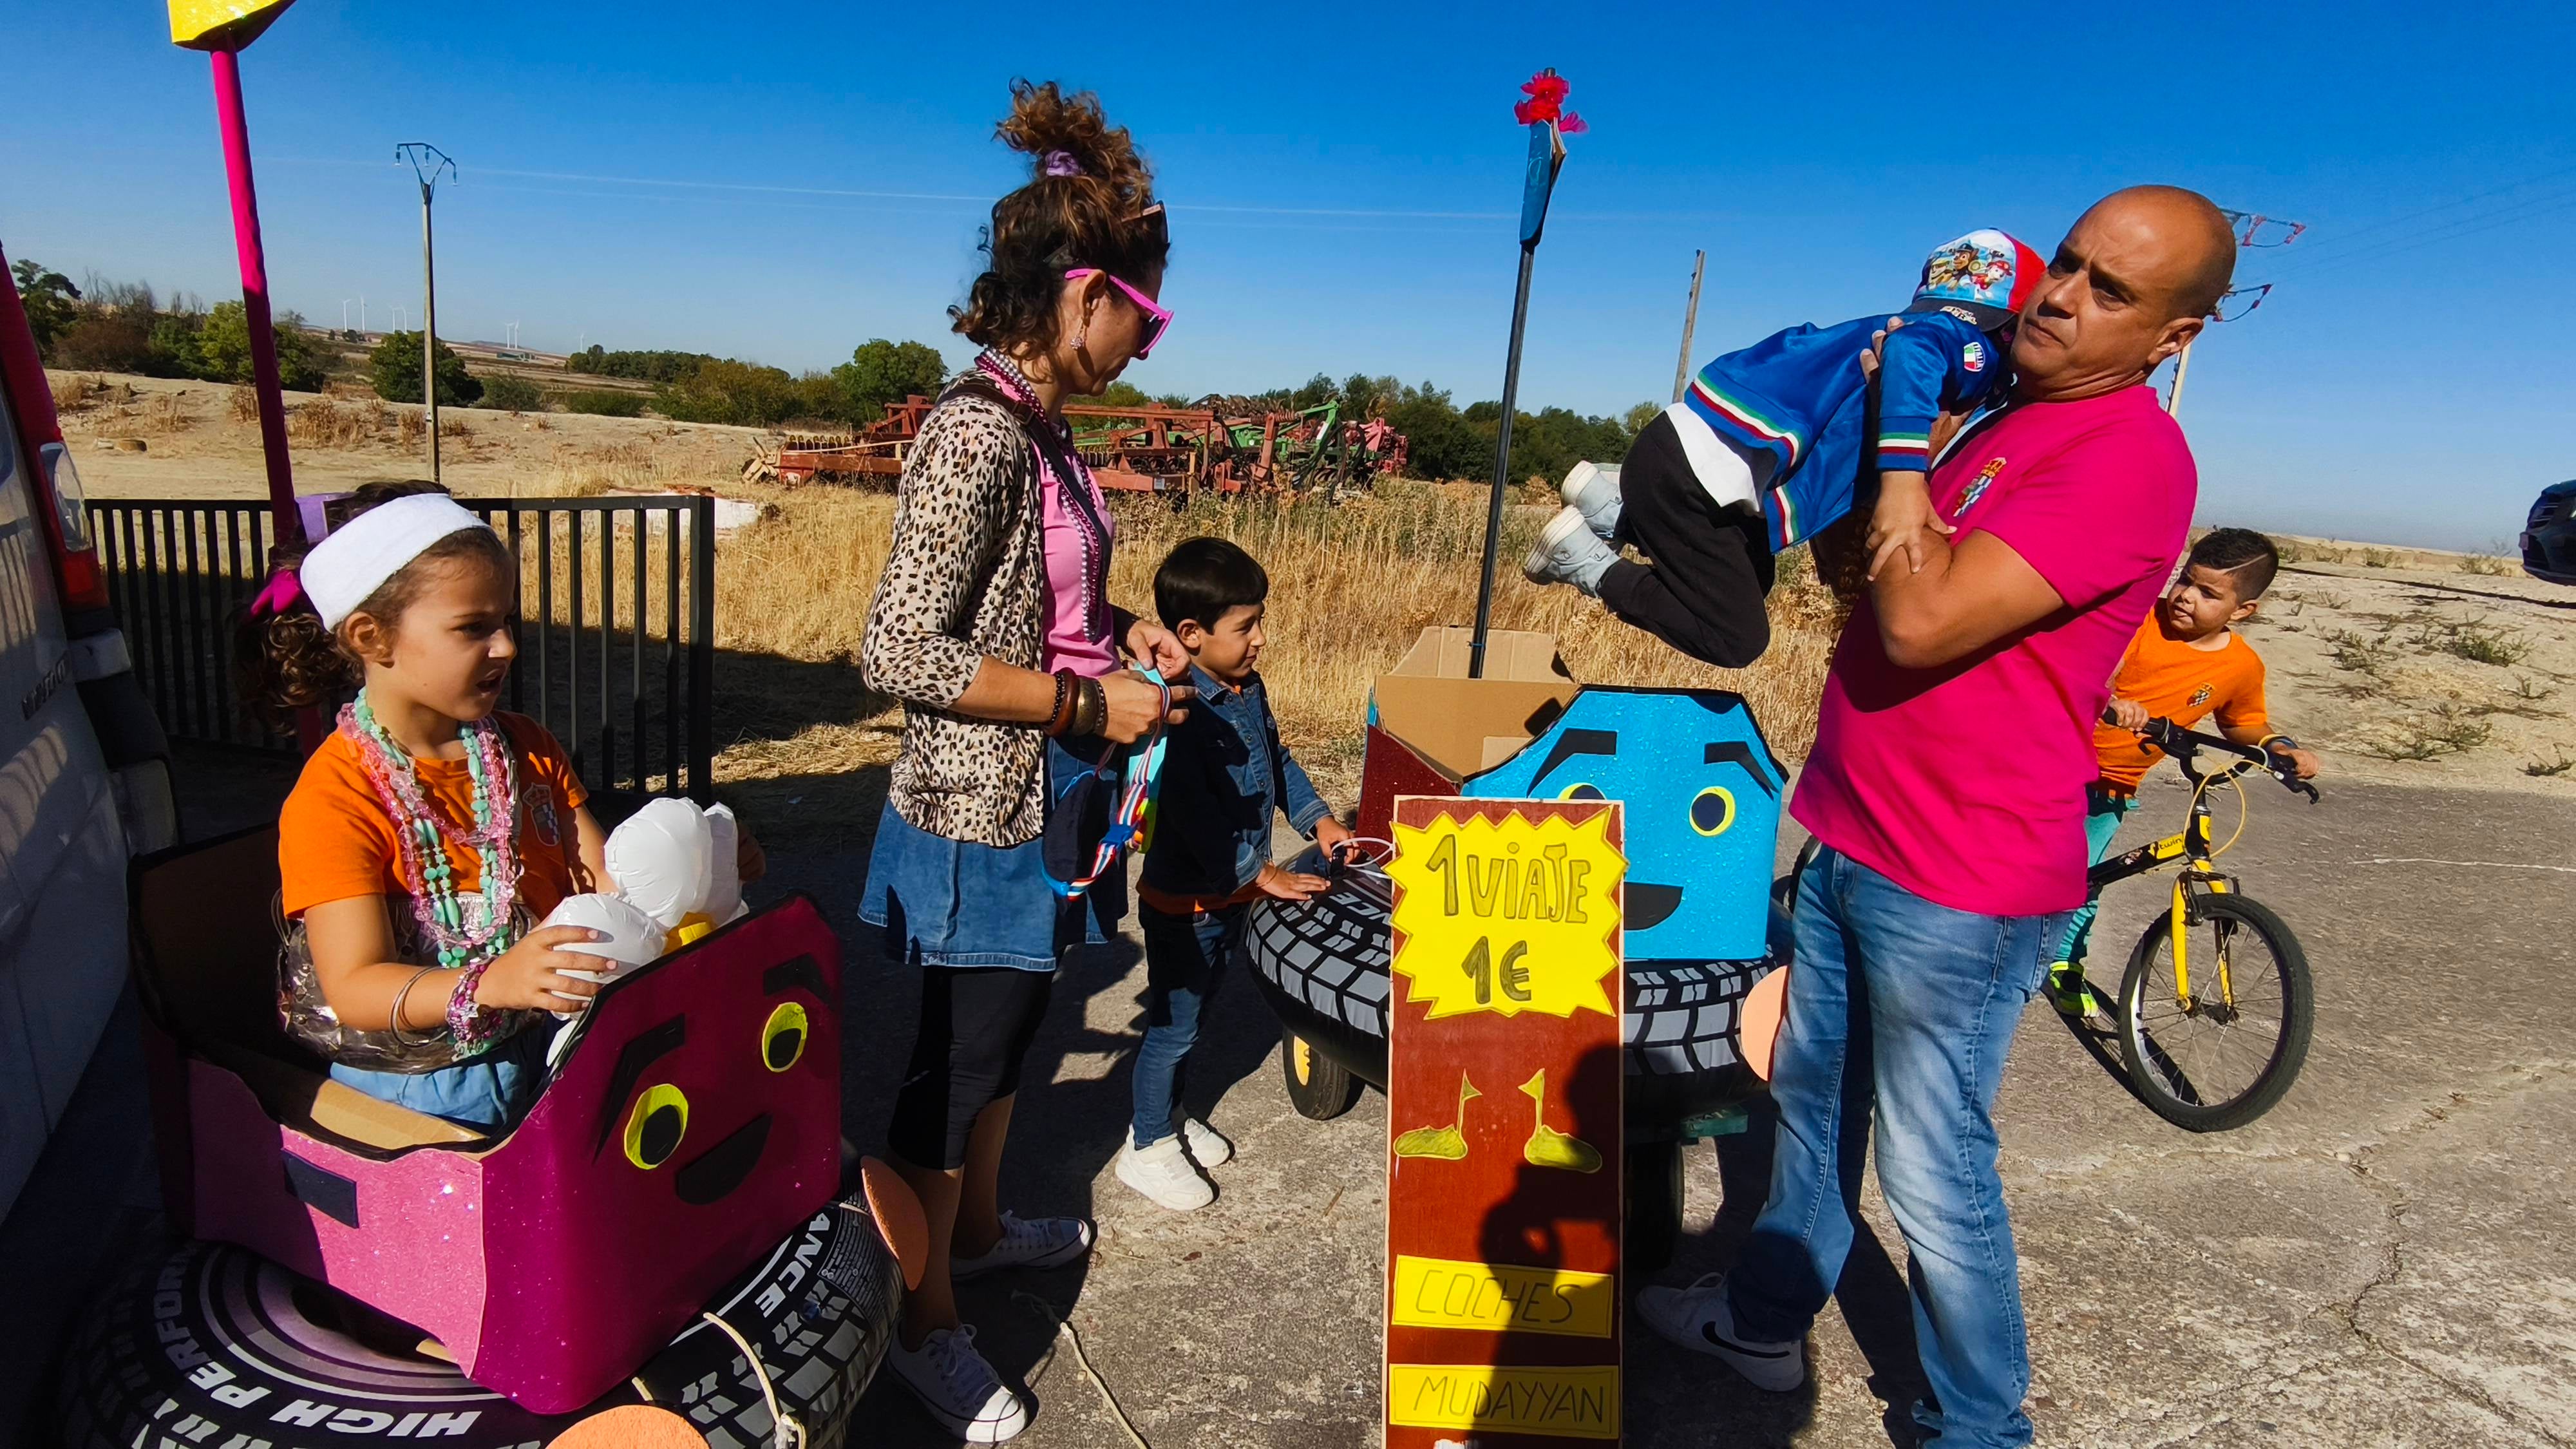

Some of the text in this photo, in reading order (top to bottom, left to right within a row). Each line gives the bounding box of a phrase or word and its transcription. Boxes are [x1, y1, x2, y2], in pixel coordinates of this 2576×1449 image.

[1425, 833, 1459, 917] 1
[1461, 935, 1532, 1005] 1€
[1416, 1269, 1582, 1323] COCHES
[268, 1399, 483, 1438] HIGH
[1413, 1375, 1604, 1423] MUDAYYAN
